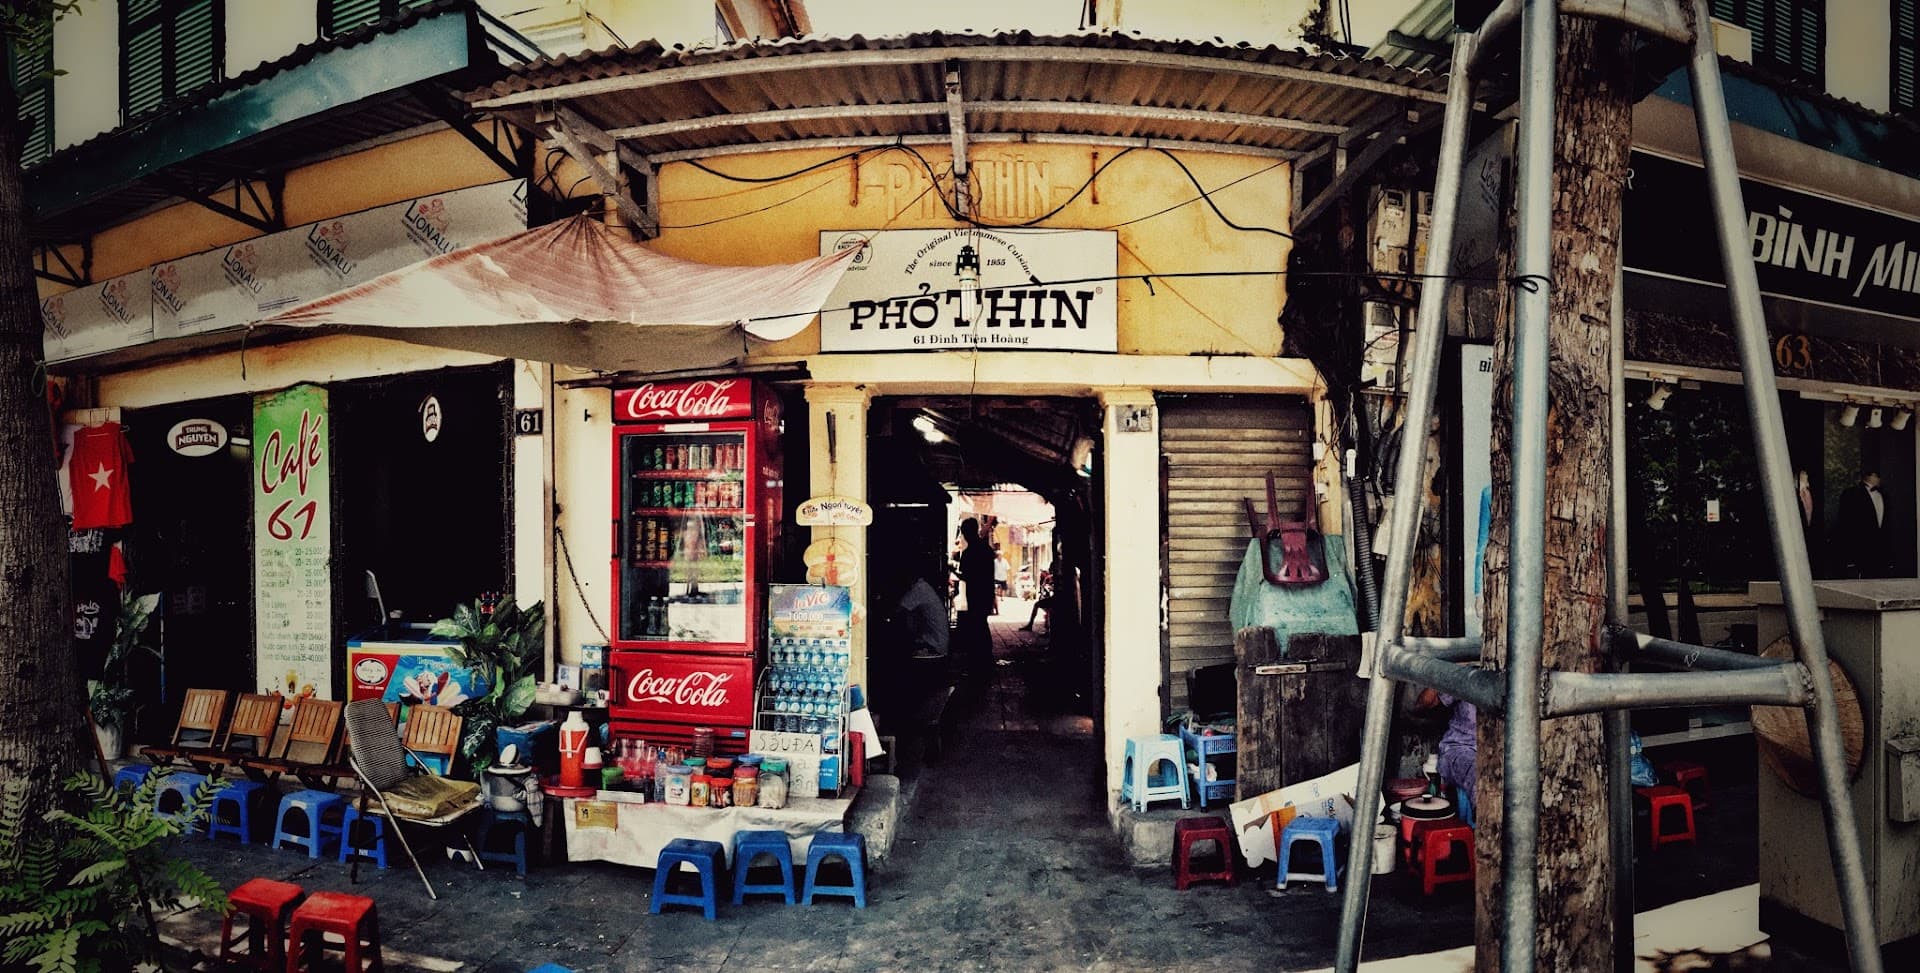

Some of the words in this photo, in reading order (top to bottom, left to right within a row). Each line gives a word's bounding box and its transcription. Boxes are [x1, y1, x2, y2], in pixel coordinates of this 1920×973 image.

[904, 258, 918, 275] The
[917, 231, 952, 258] Original
[1007, 243, 1031, 275] Cuisine
[1749, 205, 1856, 280] BÌNH
[929, 259, 953, 267] since
[986, 258, 1006, 267] 1955
[849, 283, 940, 330] PHỞ
[913, 335, 926, 345] 61
[991, 333, 1029, 345] Hoàng
[1776, 334, 1812, 370] 63
[628, 379, 736, 418] Coca-Cola
[520, 413, 541, 433] 61
[261, 409, 322, 496] Café
[268, 500, 317, 540] 61
[628, 668, 733, 707] Coca-Cola
